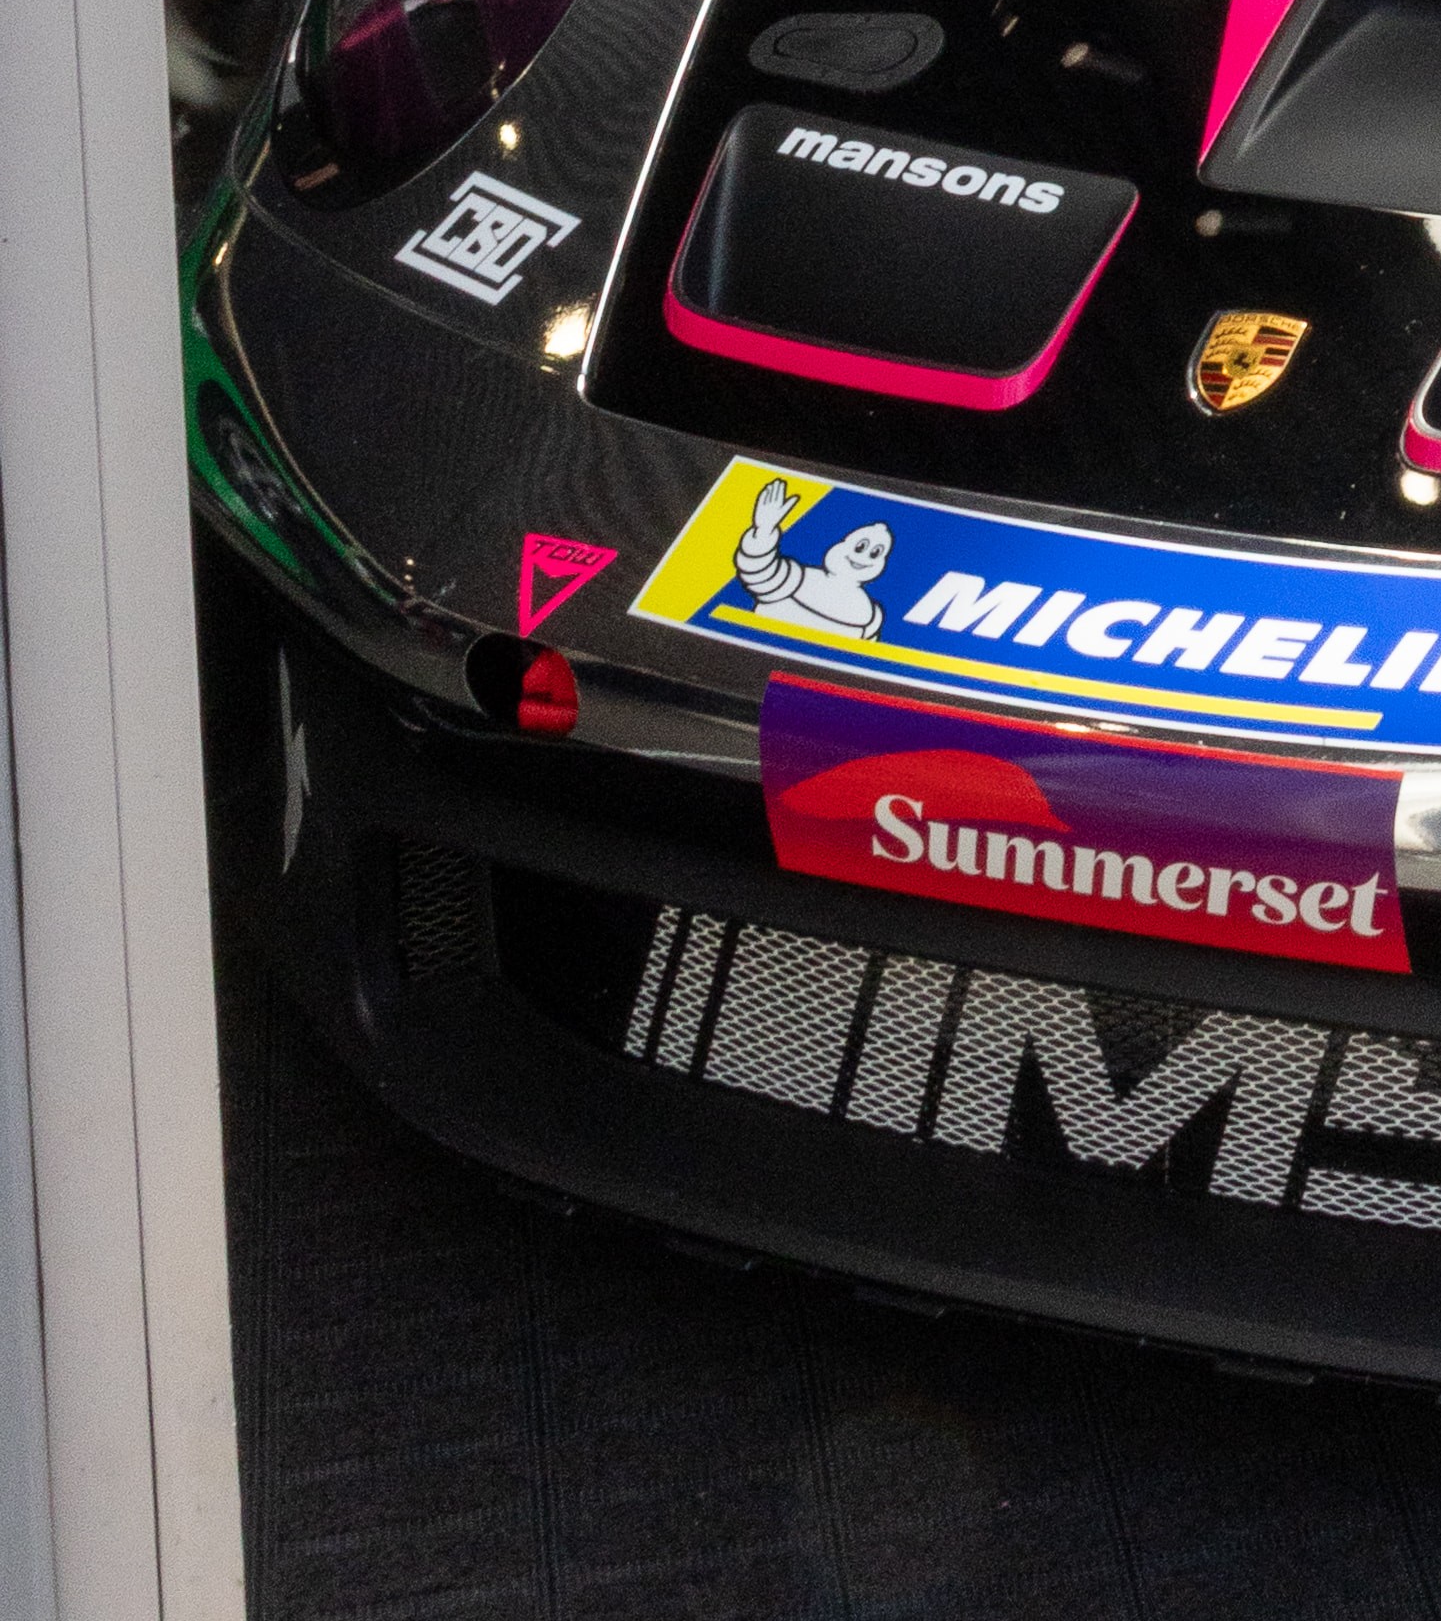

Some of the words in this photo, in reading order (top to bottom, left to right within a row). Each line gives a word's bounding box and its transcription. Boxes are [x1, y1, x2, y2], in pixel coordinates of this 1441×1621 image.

[775, 125, 1067, 215] mansons
[530, 539, 605, 566] TOW
[871, 792, 1390, 939] Summerset
